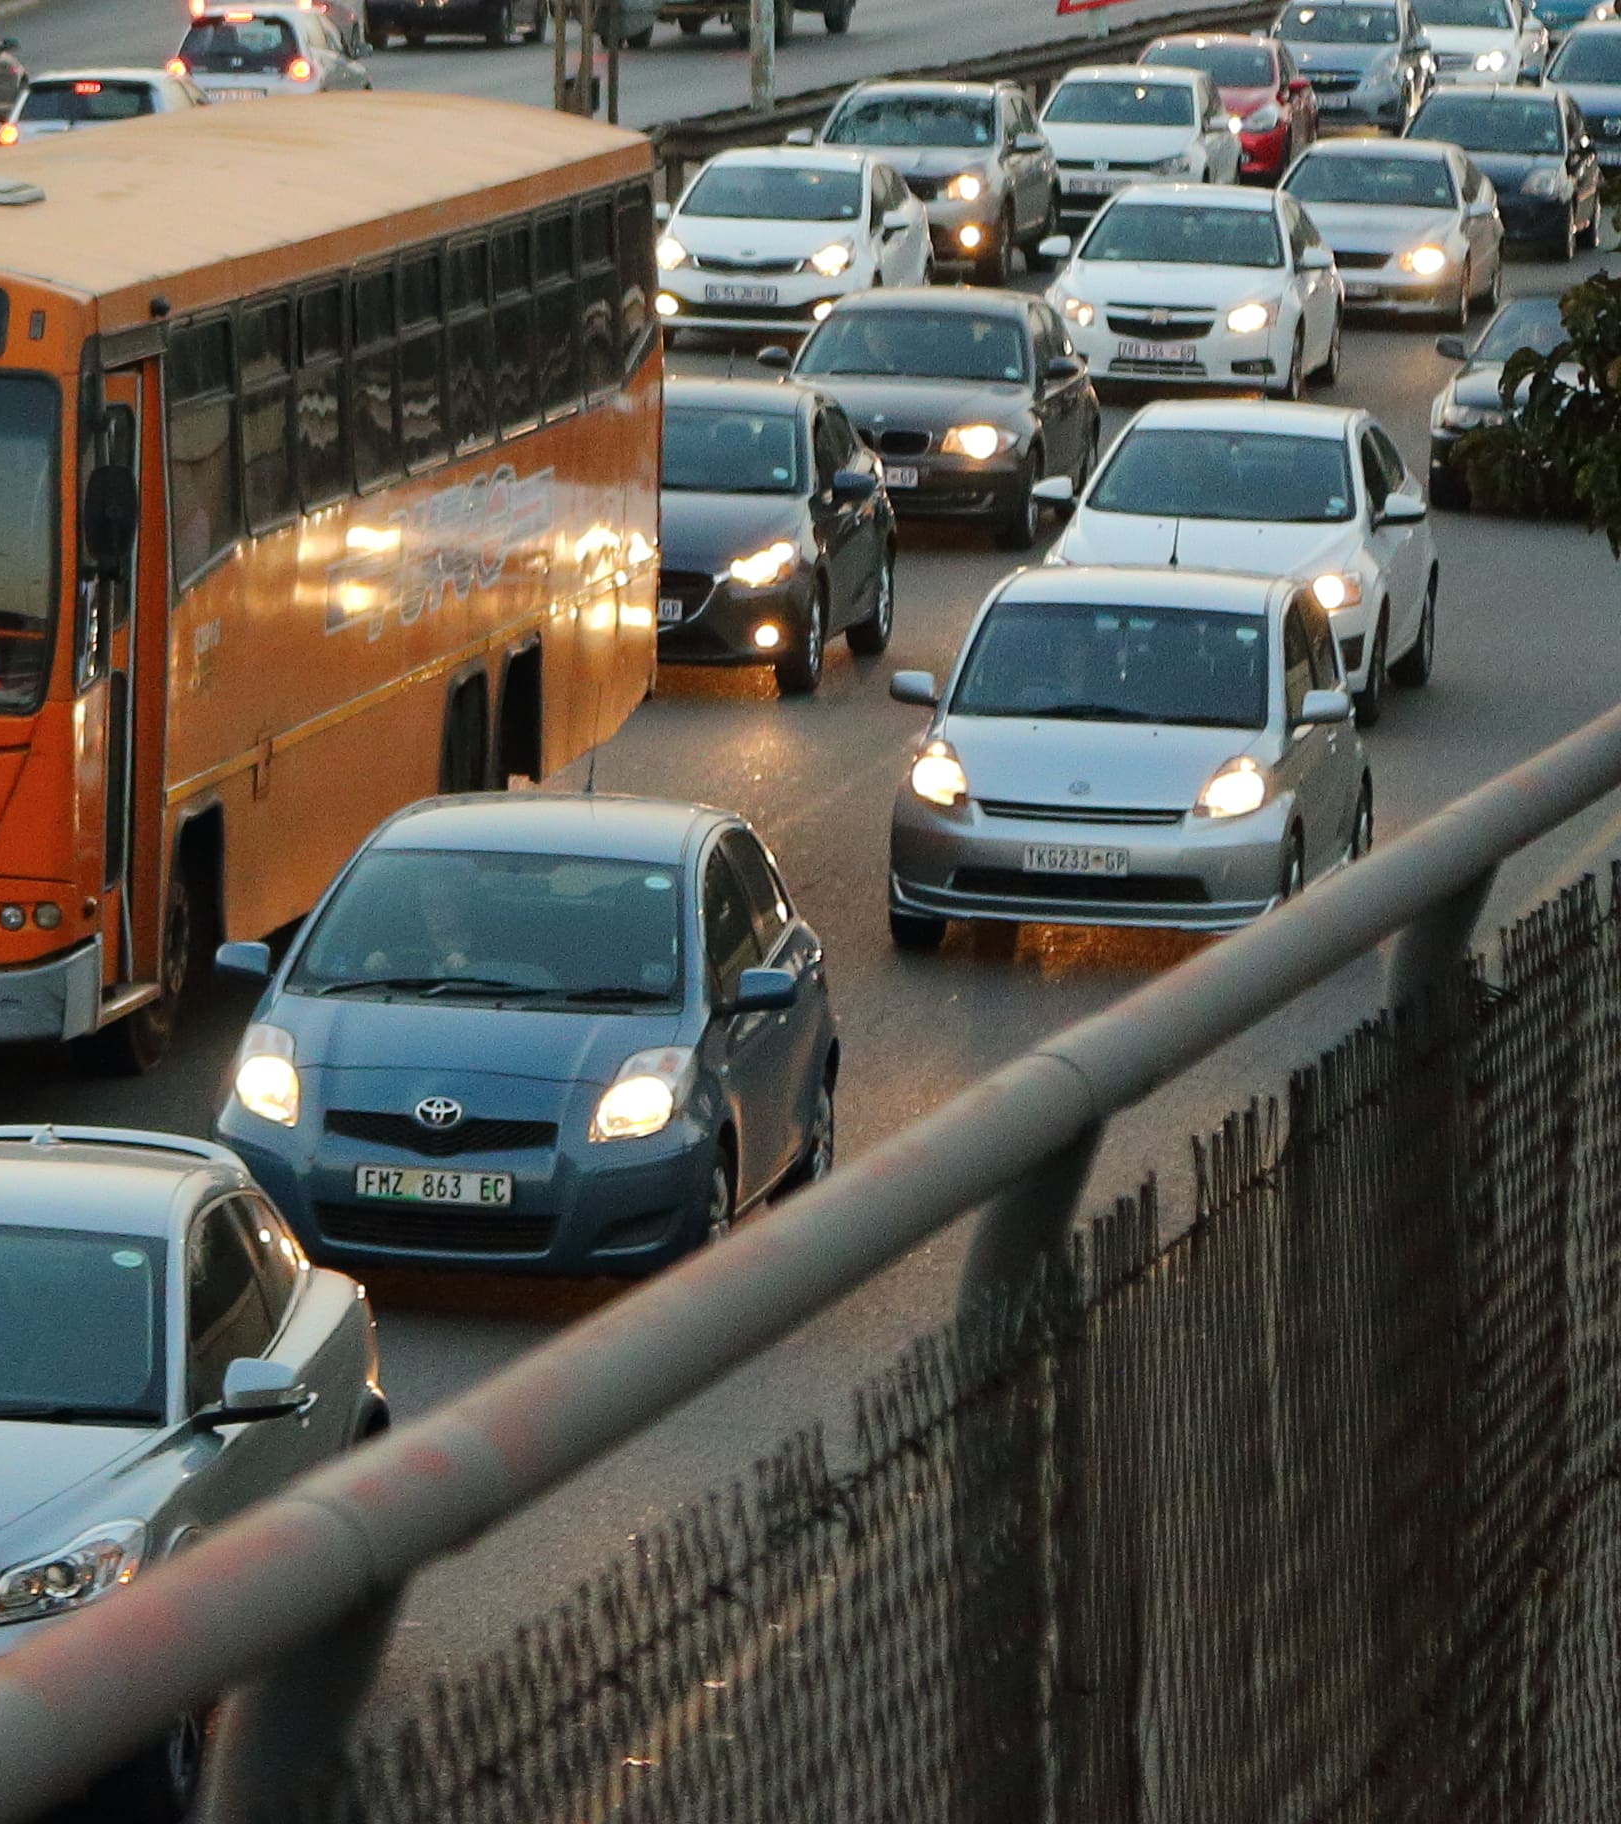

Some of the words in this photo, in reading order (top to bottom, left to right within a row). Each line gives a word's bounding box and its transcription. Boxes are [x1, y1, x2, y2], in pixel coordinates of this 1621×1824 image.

[365, 1170, 404, 1197] FMZ
[422, 1174, 462, 1199] 863
[479, 1177, 506, 1203] EC
